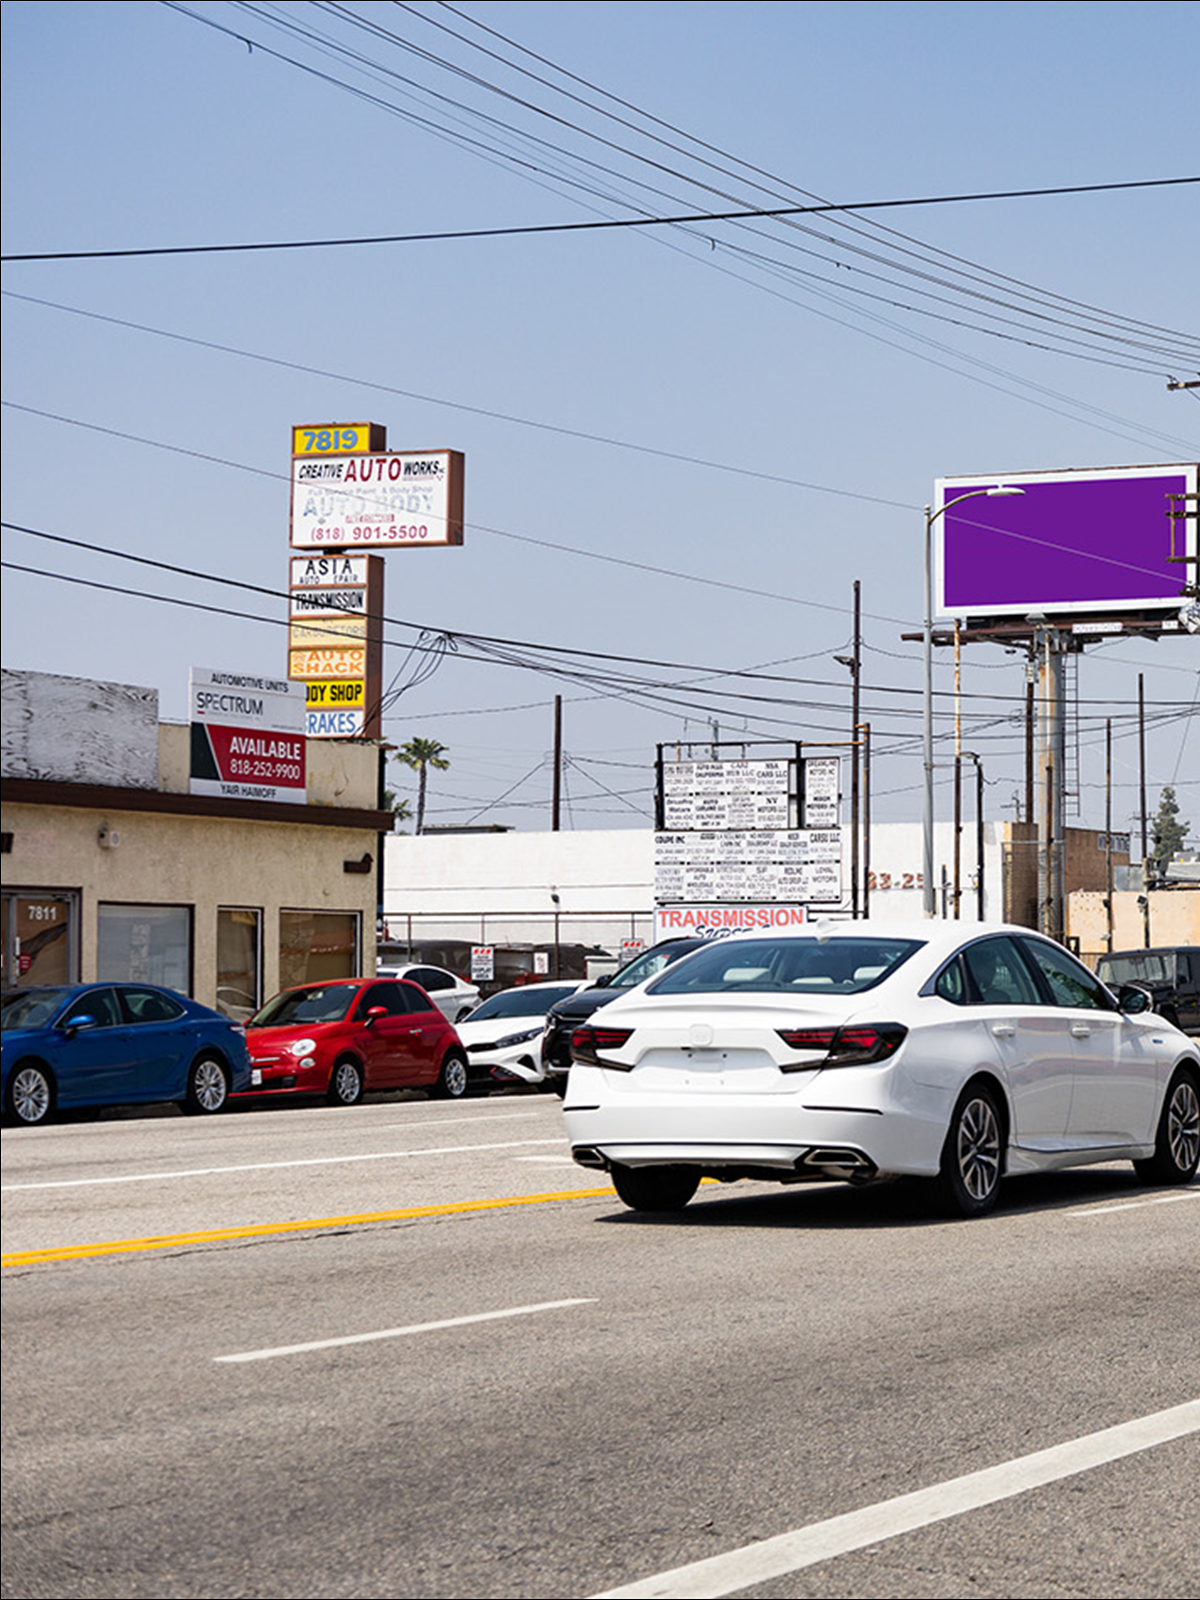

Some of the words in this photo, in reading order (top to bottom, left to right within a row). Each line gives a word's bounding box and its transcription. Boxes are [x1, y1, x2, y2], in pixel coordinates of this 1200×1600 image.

[303, 430, 358, 450] 7819
[299, 463, 344, 479] CREATIVE
[344, 458, 401, 482] AUTO
[404, 461, 439, 475] WORKS
[311, 527, 345, 541] (818)
[353, 525, 428, 540] 901-5500
[305, 559, 352, 576] ASIA
[299, 576, 320, 585] AUTO
[296, 592, 363, 610] TRANSMISSION
[308, 651, 363, 662] AUTO
[293, 662, 363, 674] SHACK
[211, 673, 265, 690] AUTOMOTIVE
[266, 680, 289, 693] UNITS
[330, 684, 362, 701] SHOP
[196, 691, 263, 716] SPECTRUM
[308, 713, 356, 734] RAKES
[229, 736, 301, 761] AVAILABLE
[230, 758, 300, 780] 818-252-9900
[28, 905, 56, 920] 7811
[658, 908, 803, 927] TRANSMISSION
